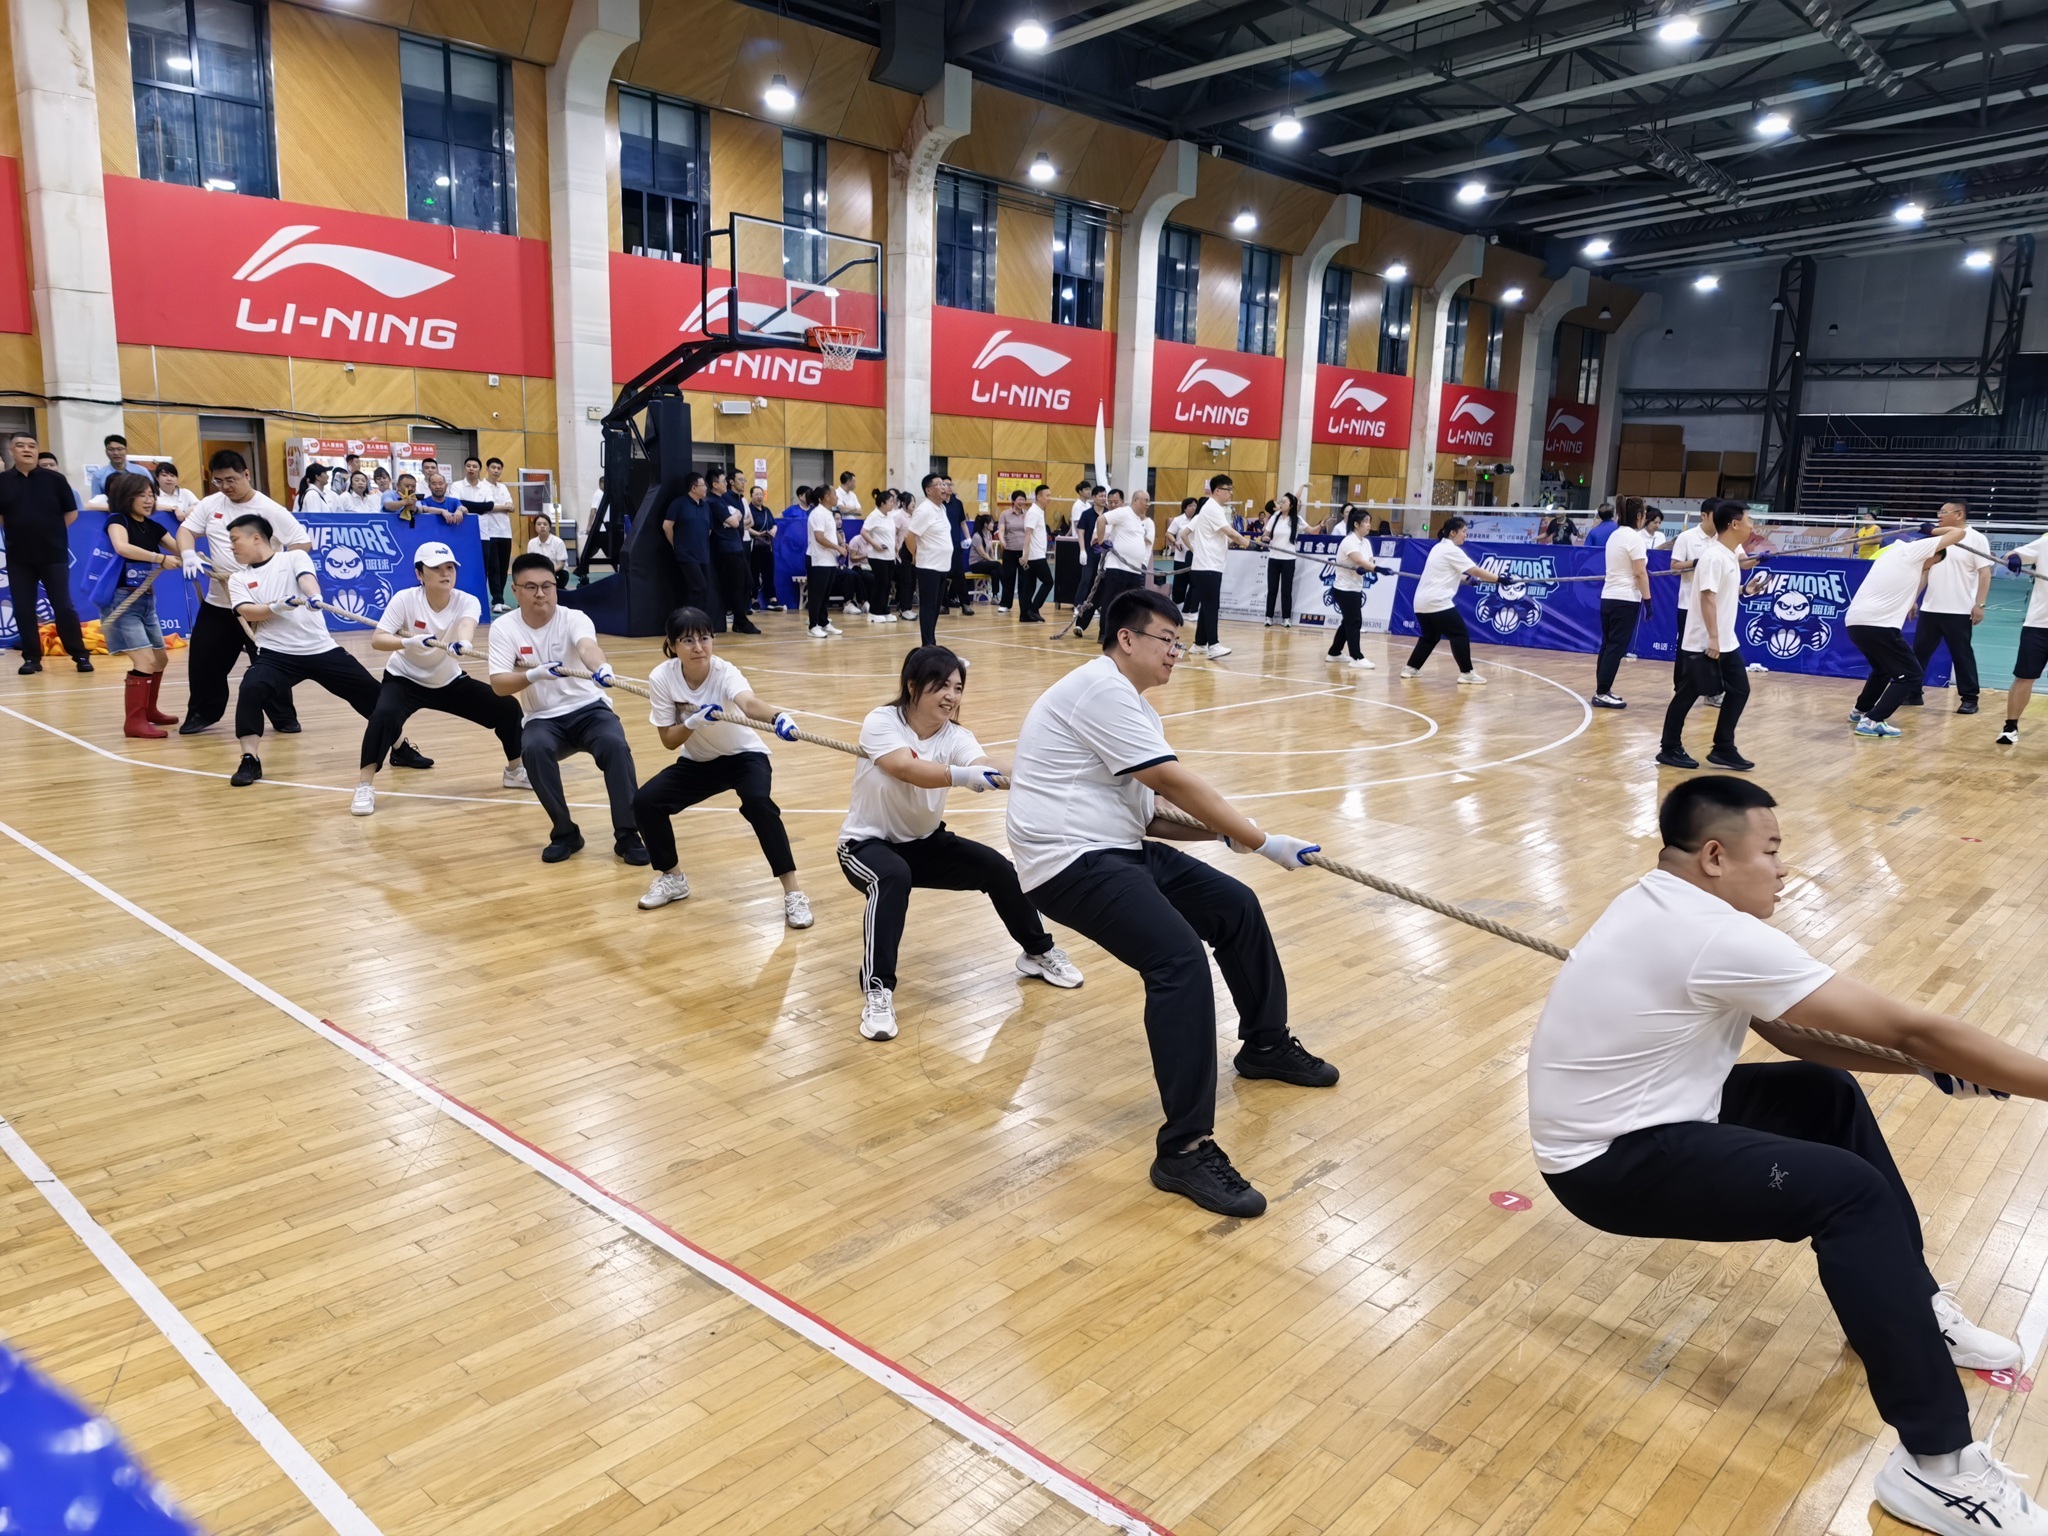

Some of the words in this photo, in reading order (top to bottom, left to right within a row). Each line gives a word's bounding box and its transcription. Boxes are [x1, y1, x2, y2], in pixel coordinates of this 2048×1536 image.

[235, 297, 458, 350] LI-NING
[680, 351, 824, 386] I-NING
[971, 379, 1071, 411] LI-NING
[1174, 401, 1250, 427] LI-NING
[1327, 416, 1386, 438] LI-NING
[1447, 428, 1494, 447] LI-NING
[1545, 438, 1583, 454] LI-NING
[299, 523, 397, 557] NEMORE
[1502, 1194, 1520, 1206] 7
[1989, 1370, 2014, 1385] 5
